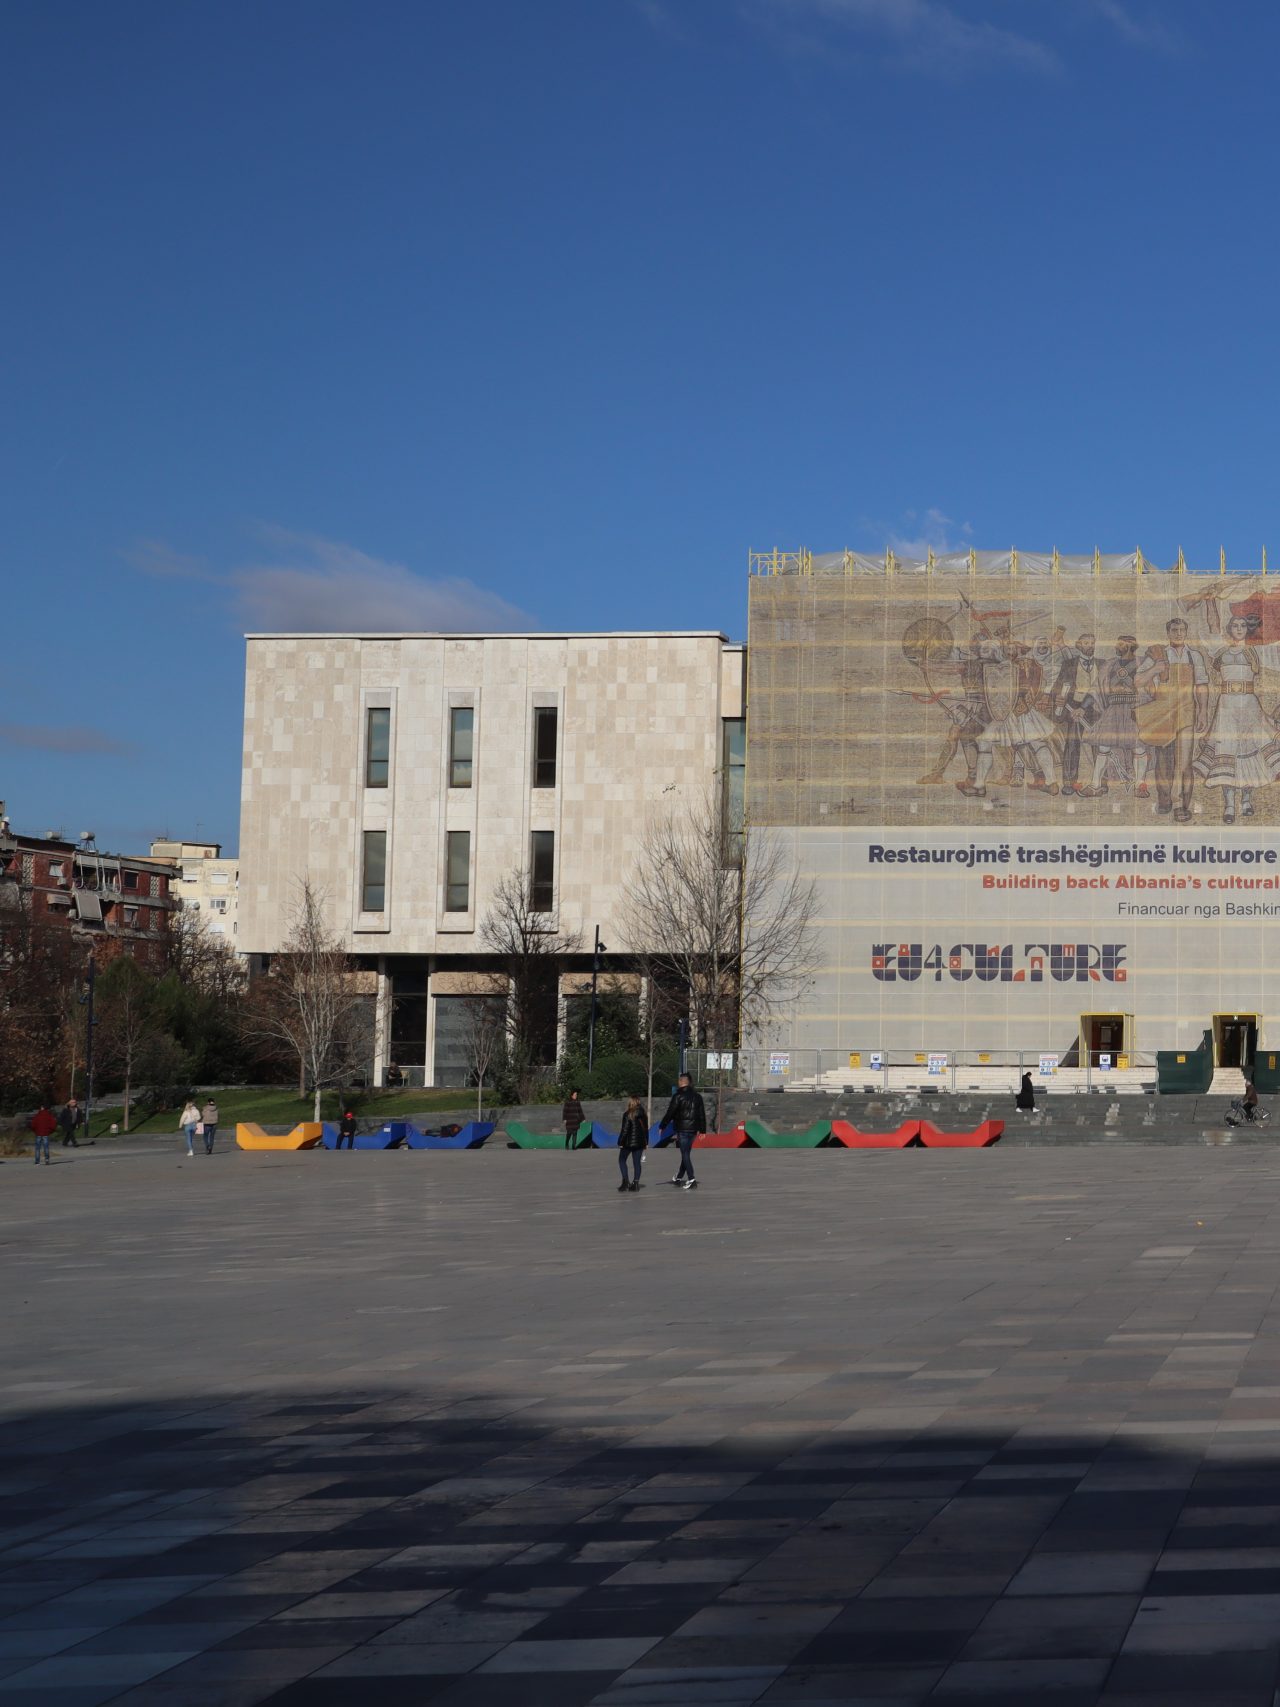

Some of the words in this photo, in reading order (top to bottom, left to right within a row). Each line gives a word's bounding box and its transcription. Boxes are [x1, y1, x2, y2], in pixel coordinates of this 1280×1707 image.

[868, 844, 1010, 868] Restaurojmë
[1016, 844, 1166, 868] trashëgiminë
[1172, 845, 1278, 864] kulturore
[982, 874, 1060, 892] Building
[1066, 874, 1109, 889] back
[1115, 874, 1202, 889] Albania’s
[1207, 874, 1280, 889] cultural
[1118, 902, 1190, 916] Financuar
[1194, 905, 1221, 918] nga
[871, 943, 1127, 982] EU4CULTURE
